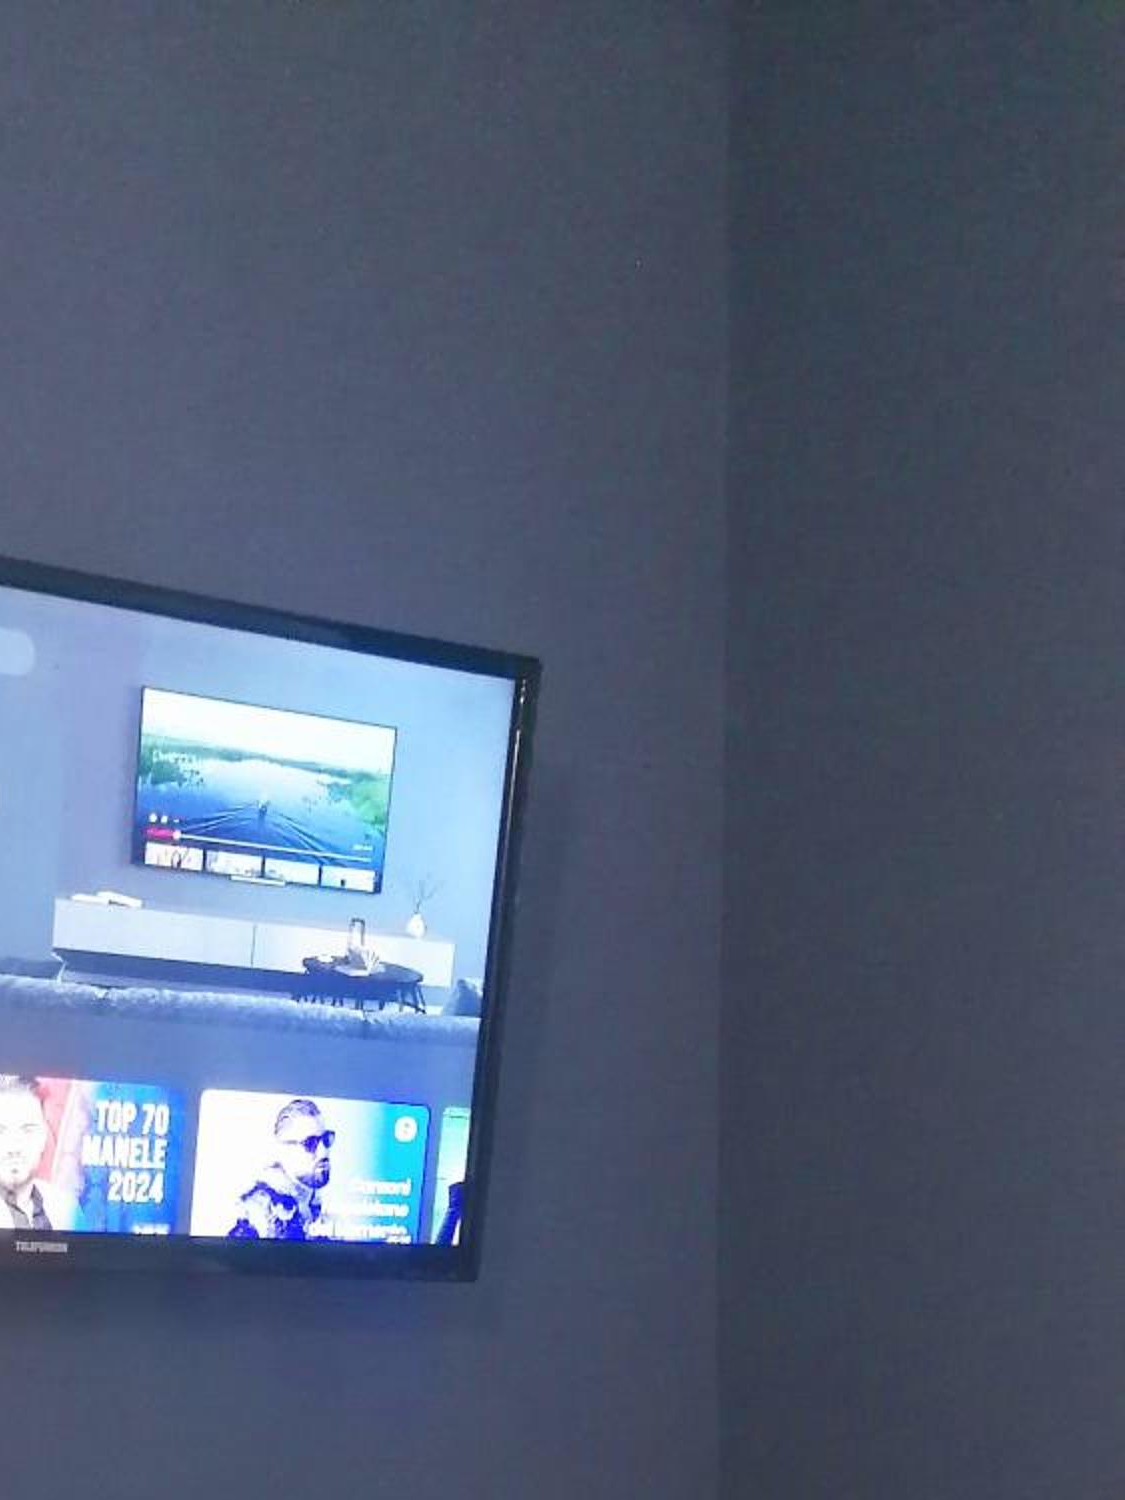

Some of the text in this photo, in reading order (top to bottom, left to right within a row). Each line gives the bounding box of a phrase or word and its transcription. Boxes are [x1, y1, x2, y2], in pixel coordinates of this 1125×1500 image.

[95, 1100, 169, 1135] TOP 70
[83, 1136, 168, 1169] MANELE
[108, 1172, 164, 1204] 2024
